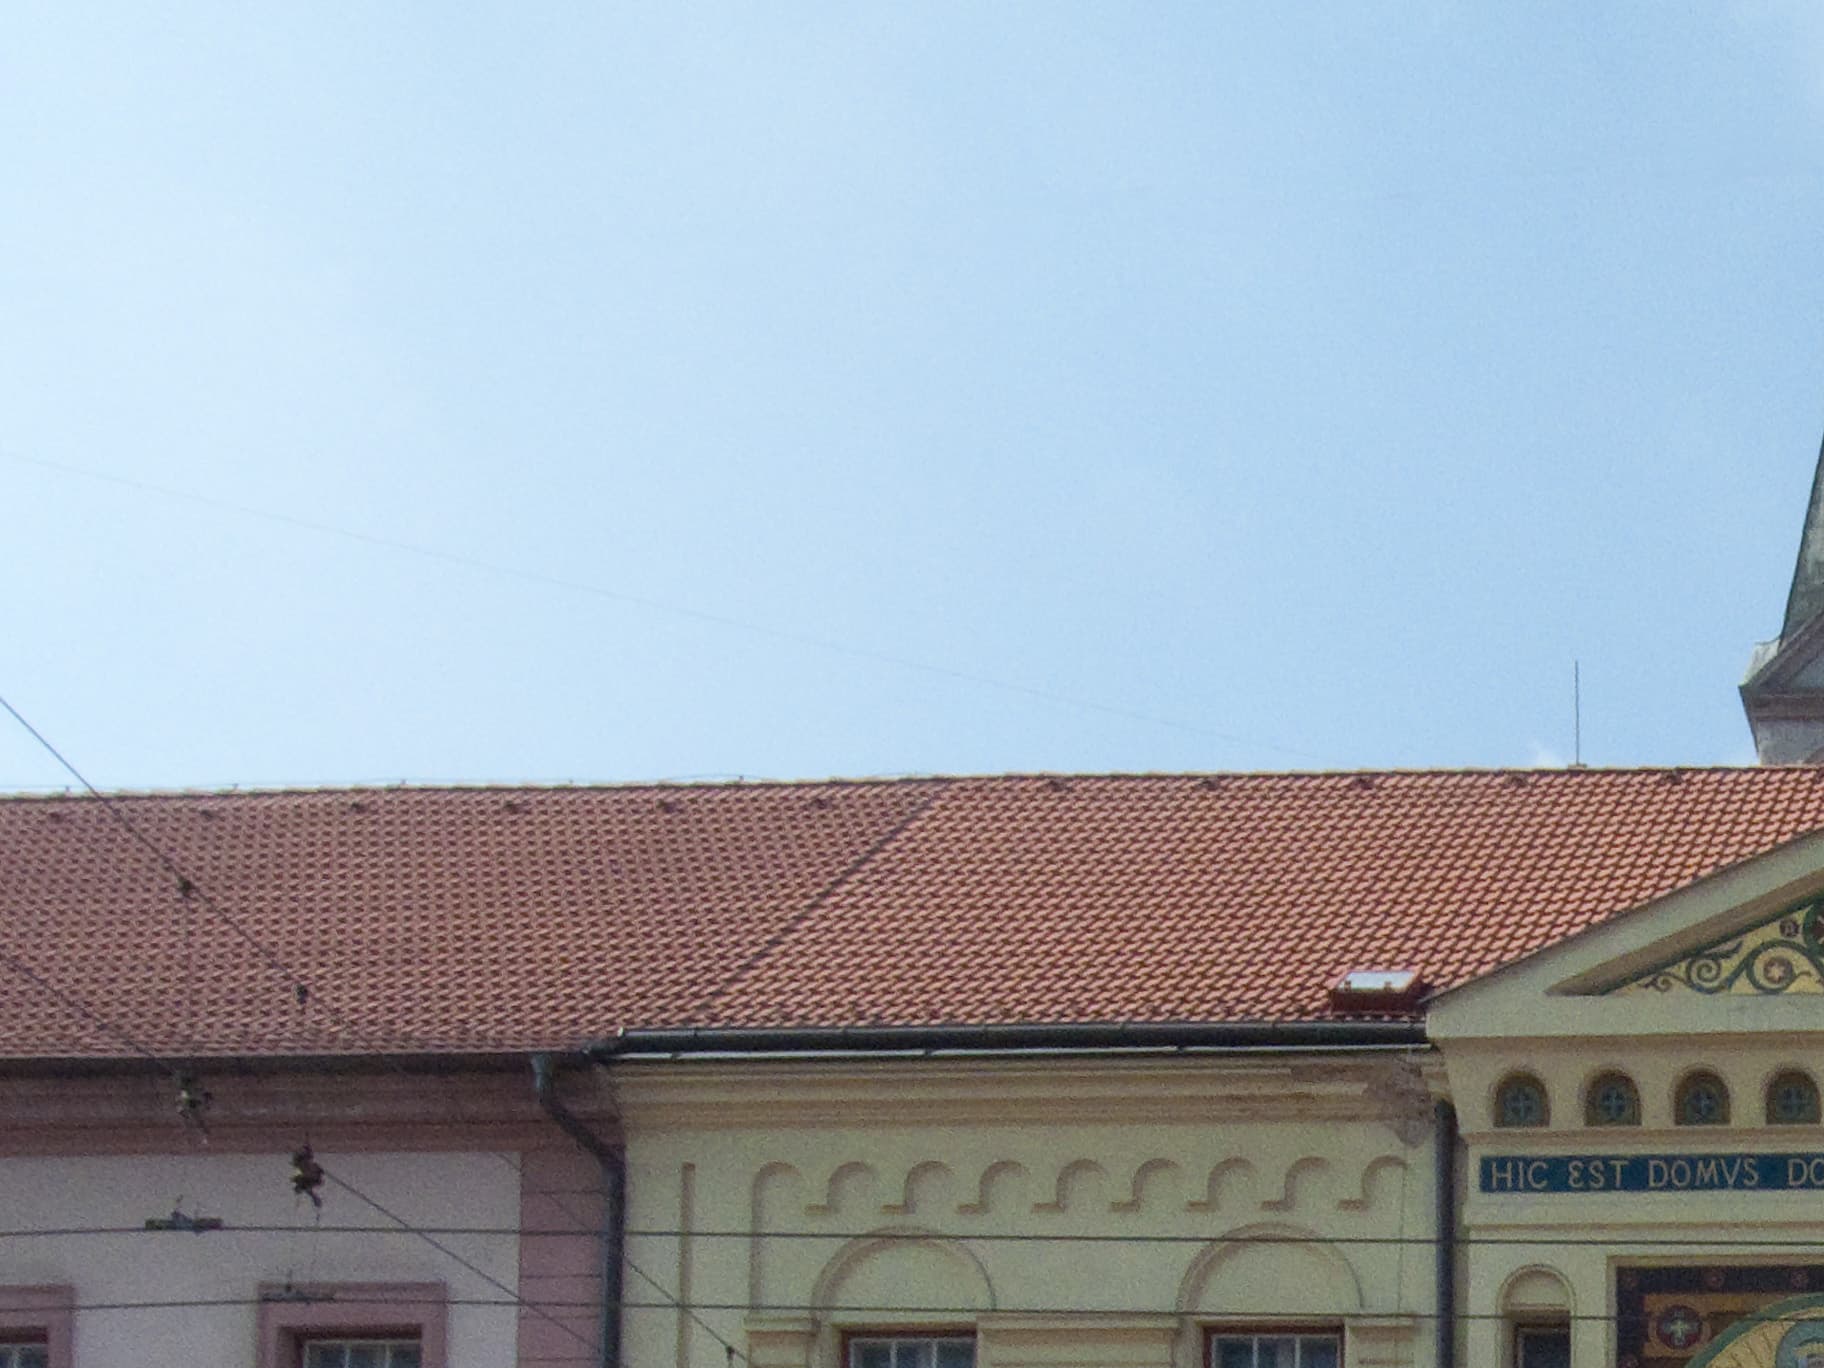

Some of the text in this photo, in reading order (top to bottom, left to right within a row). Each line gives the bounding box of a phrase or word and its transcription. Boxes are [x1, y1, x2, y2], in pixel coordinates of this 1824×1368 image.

[1491, 1160, 1549, 1189] HIC
[1568, 1159, 1630, 1188] EST
[1649, 1158, 1760, 1188] DOMVS
